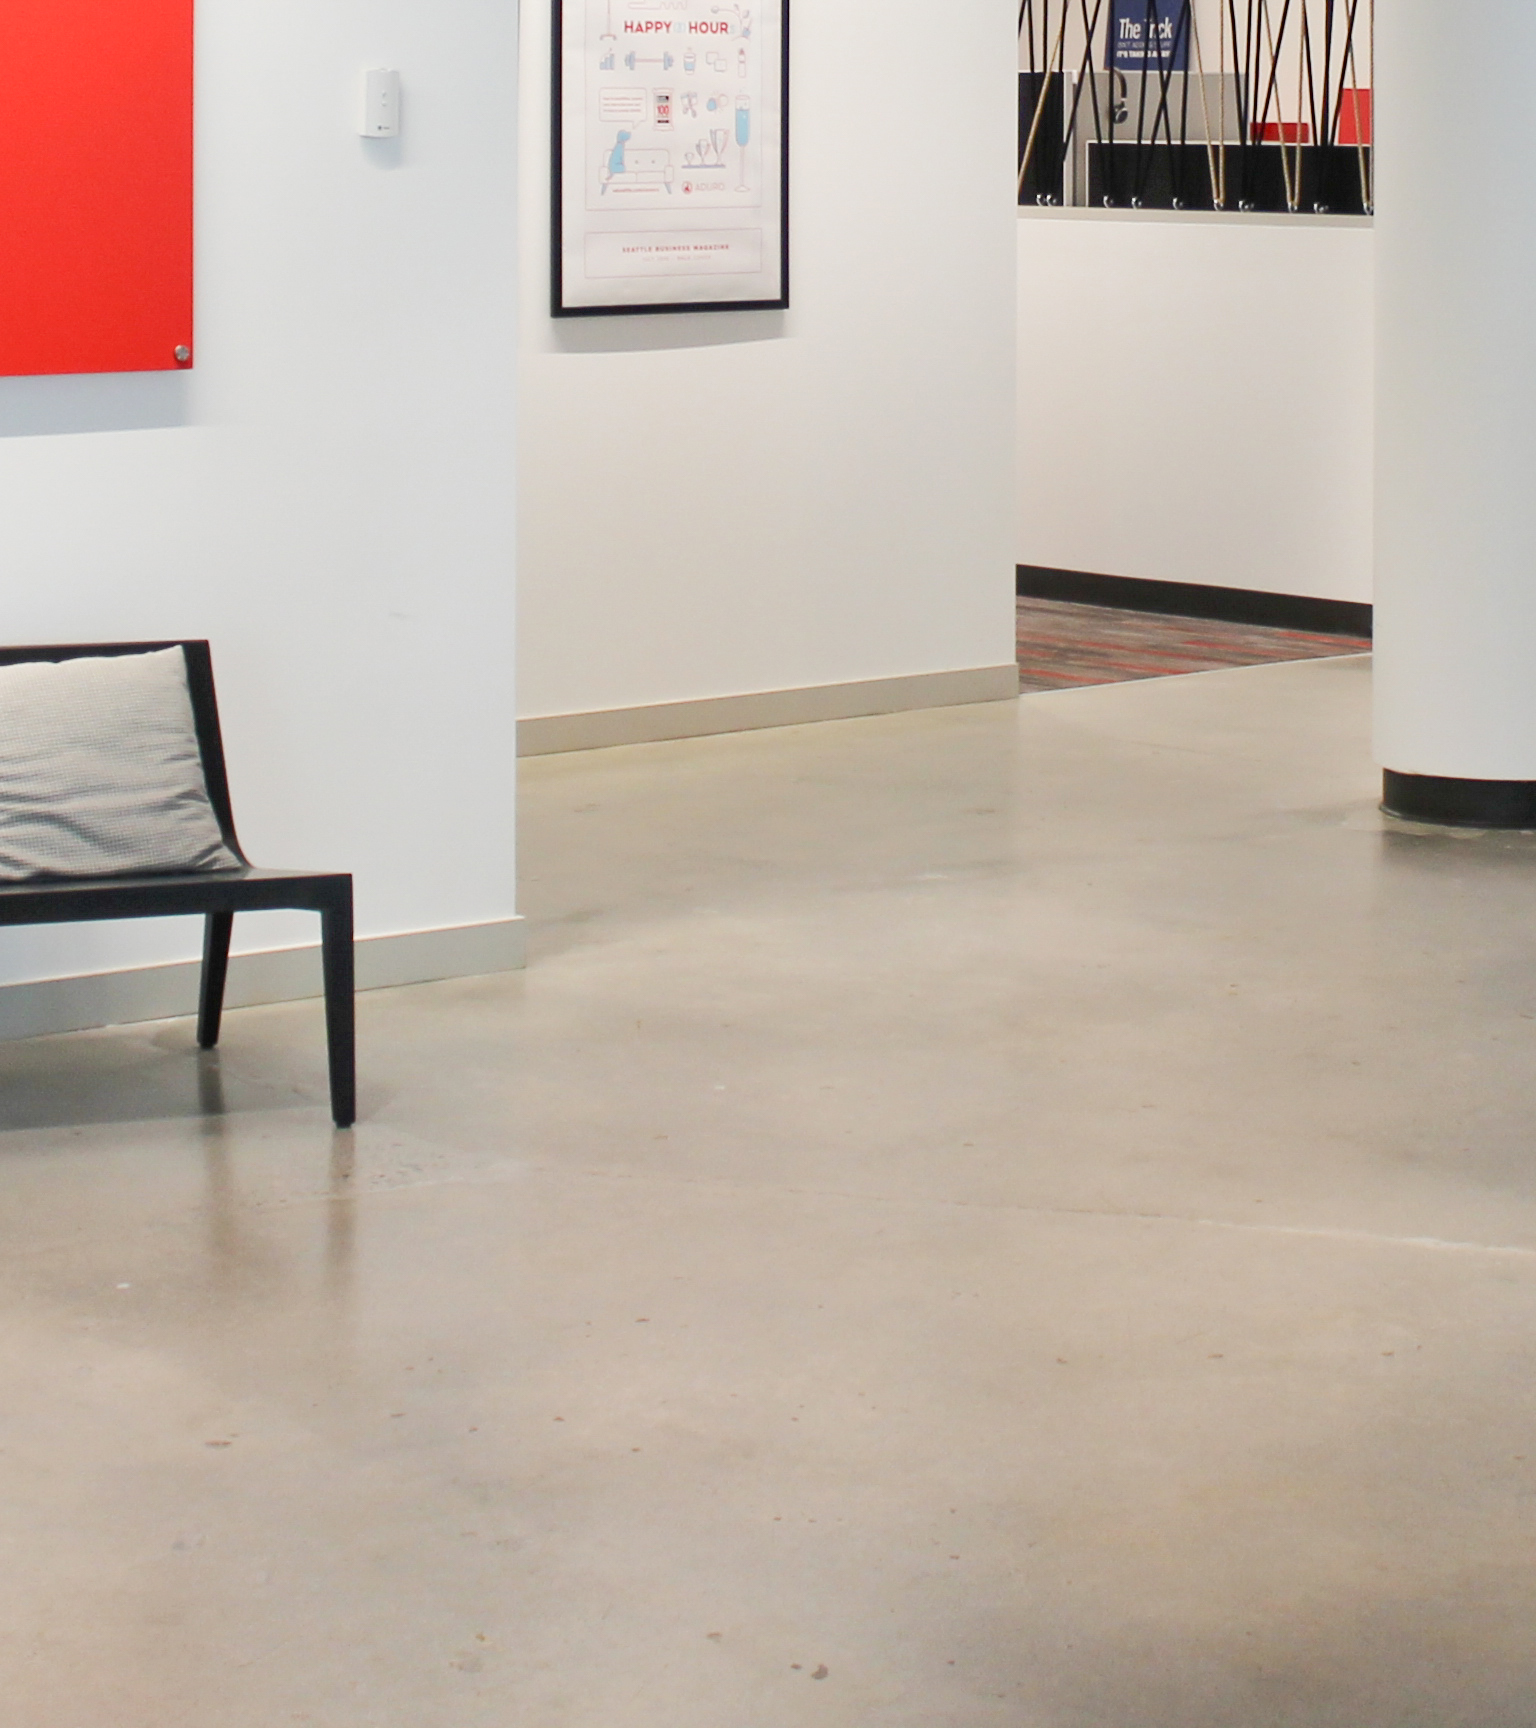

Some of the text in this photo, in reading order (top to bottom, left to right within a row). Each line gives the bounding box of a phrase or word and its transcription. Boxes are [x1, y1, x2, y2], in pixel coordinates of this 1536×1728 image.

[624, 20, 672, 33] HAPPY
[1120, 17, 1172, 39] The rck
